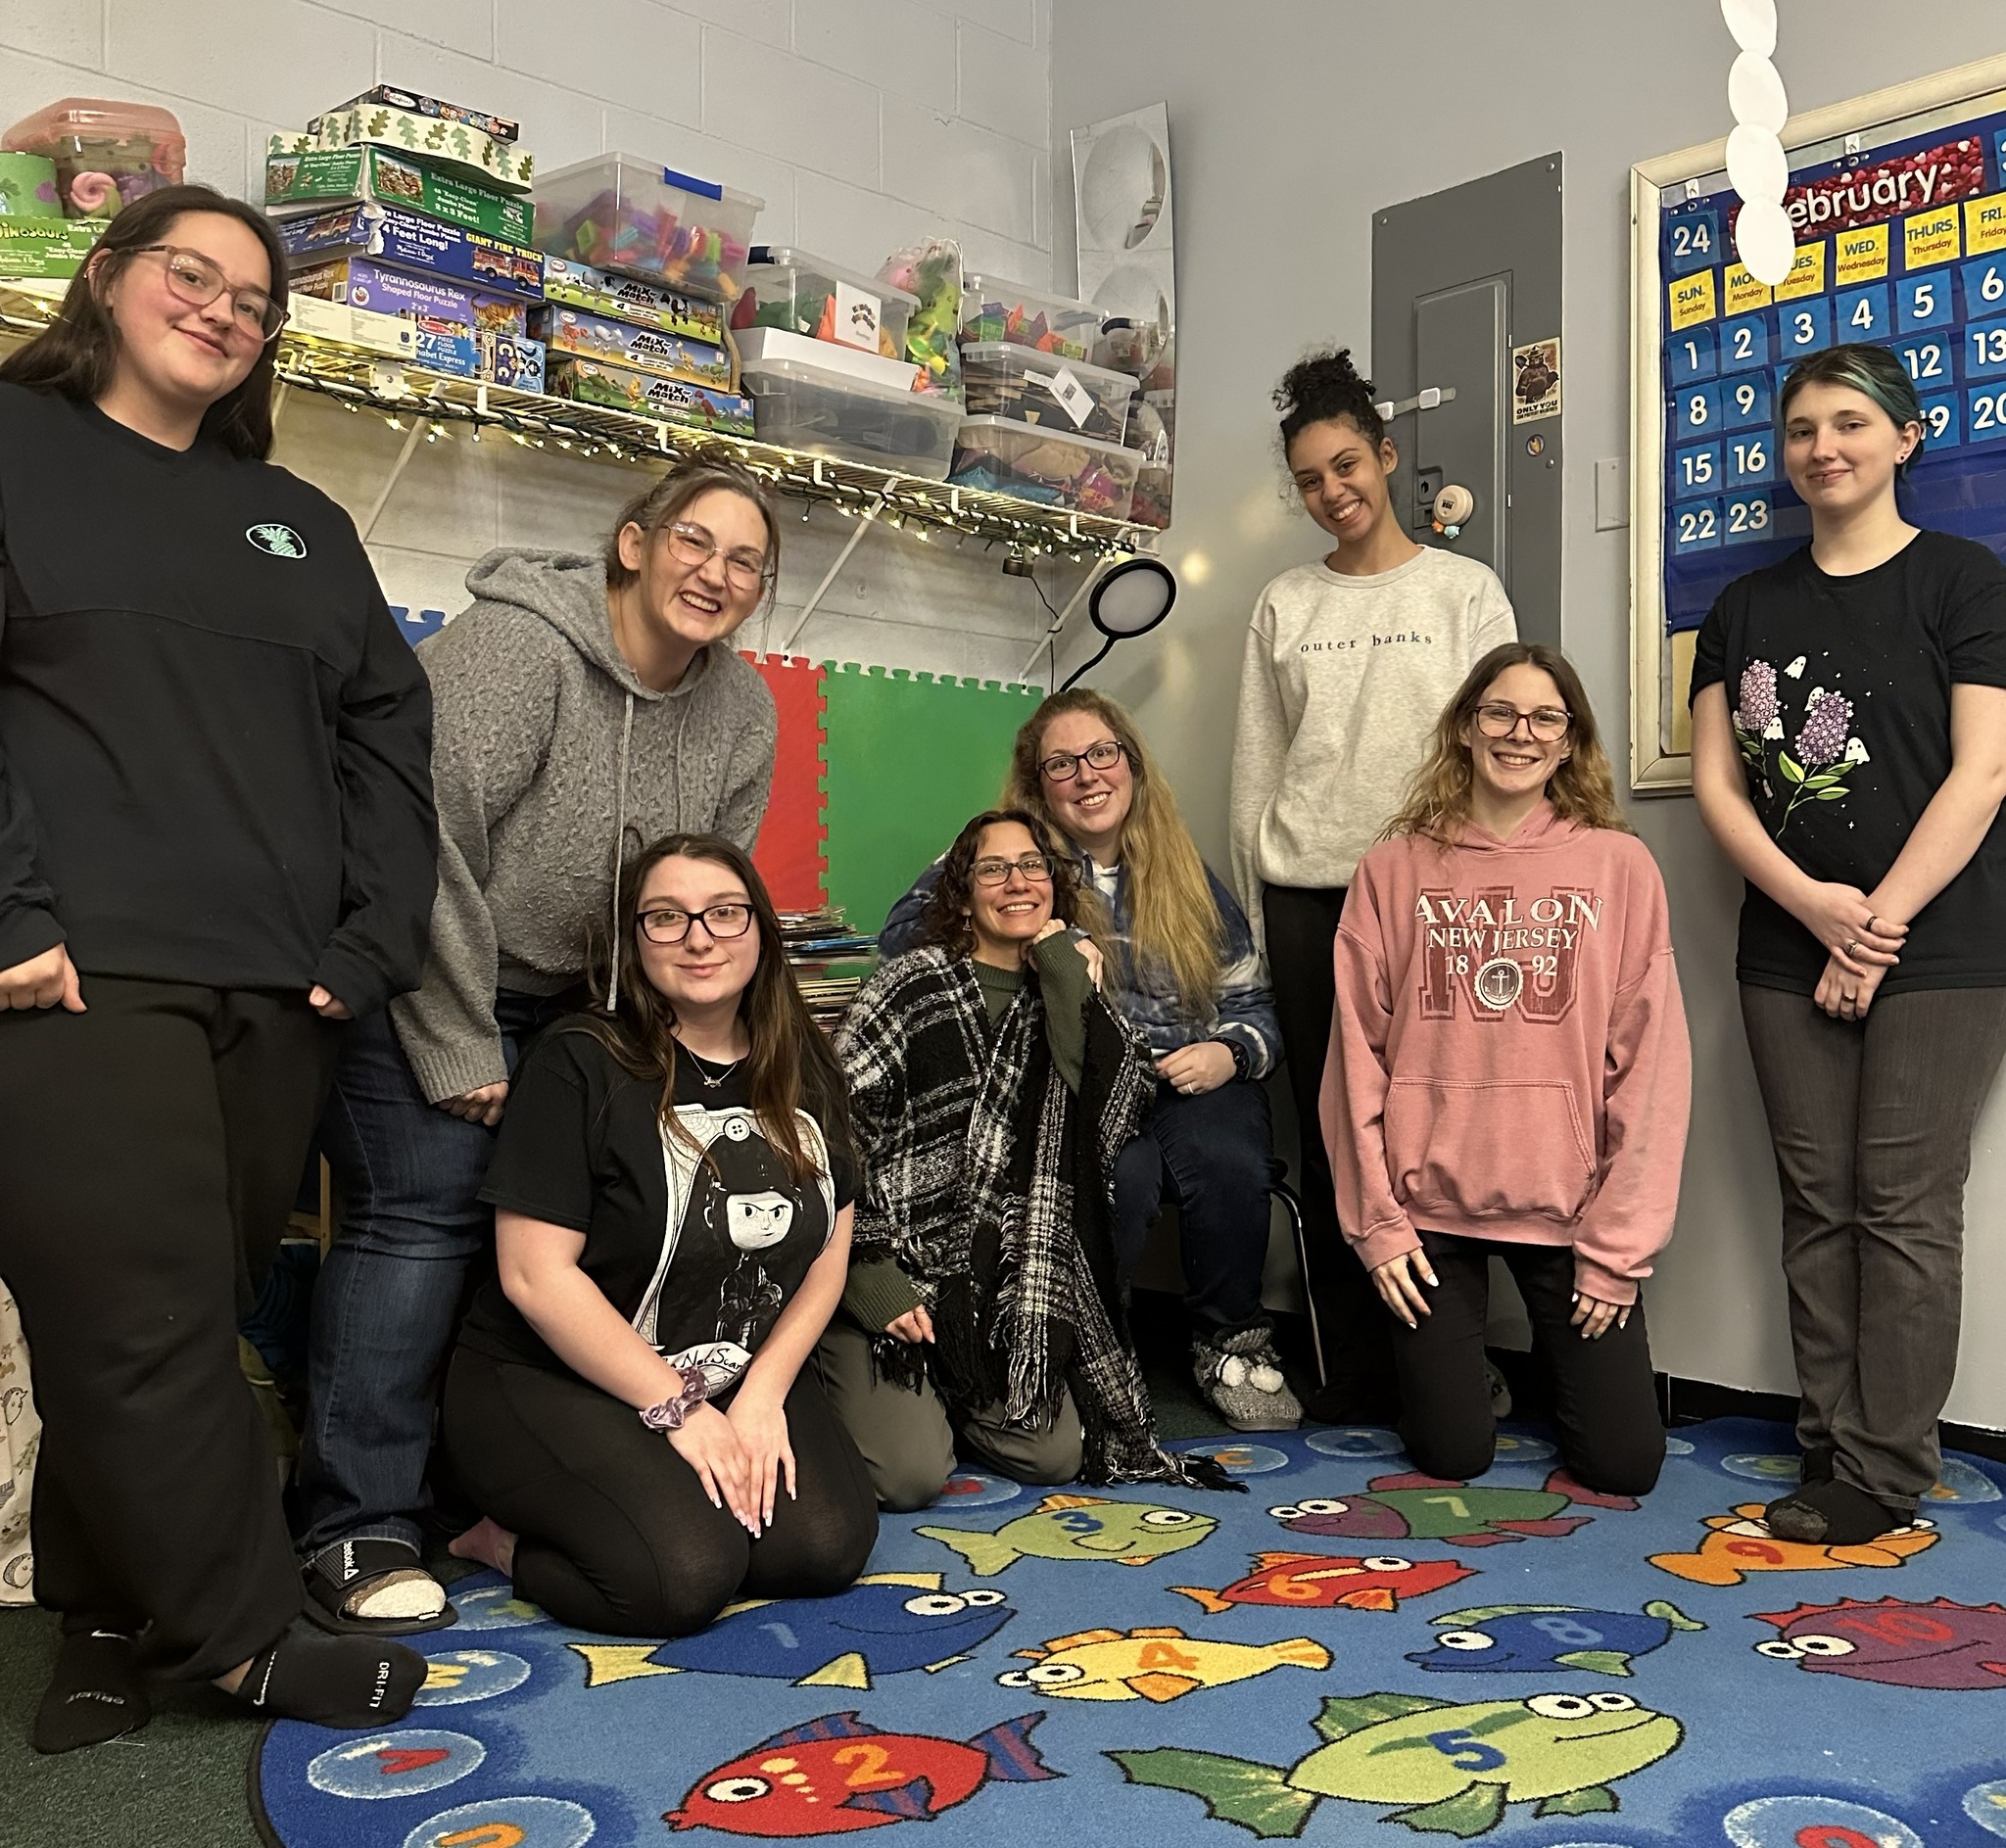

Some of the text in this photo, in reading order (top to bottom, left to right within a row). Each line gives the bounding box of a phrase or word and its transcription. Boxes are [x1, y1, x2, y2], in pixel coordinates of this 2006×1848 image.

[431, 171, 524, 212] Extra Large Floor Puzzle
[1788, 164, 1937, 228] ebruary
[393, 212, 415, 224] Large
[416, 217, 437, 229] Floor
[437, 224, 461, 237] Puzzle
[1981, 207, 2006, 223] FRI.
[382, 223, 391, 233] 4
[393, 226, 417, 241] Feet
[419, 233, 449, 252] Long!
[1674, 223, 1711, 257] 24
[1906, 218, 1957, 242] THURS.
[465, 232, 544, 262] GIANT FIRE TRUCK
[1844, 240, 1880, 257] WED.
[1912, 239, 1952, 256] Thursday
[1791, 256, 1817, 270] UES.
[1838, 256, 1887, 273] Wednesday
[373, 268, 466, 302] Tyrannosaurus Rex
[1730, 272, 1755, 288] MO
[1982, 266, 2005, 301] 6
[381, 283, 458, 308] Shaped Floor Puzzle
[617, 289, 655, 305] Match
[1677, 285, 1705, 304] SUN.
[1732, 287, 1763, 302] Monday
[1912, 284, 1934, 318] 5
[1679, 302, 1706, 316] Sunday
[1851, 298, 1874, 330] 4
[416, 331, 437, 350] 27
[437, 335, 454, 344] PIECE
[1793, 312, 1814, 345] 3
[630, 340, 668, 355] Match
[1685, 341, 1697, 370] 1
[1734, 328, 1753, 360] 2
[1973, 328, 2006, 364] 13
[439, 353, 466, 365] Express
[1903, 344, 1943, 380] 12
[647, 389, 689, 403] Match
[1516, 403, 1539, 414] ONLY
[1540, 400, 1558, 408] YOU
[1690, 395, 1707, 425] 8
[1735, 384, 1755, 415] 9
[1682, 452, 1713, 486] 15
[1734, 442, 1766, 475] 16
[1679, 508, 1716, 543] 22
[1729, 499, 1768, 533] 23
[1301, 630, 1433, 653] outer banks
[1415, 892, 1604, 932] AVALON
[1428, 926, 1578, 955] NEW JERSEY
[1445, 955, 1558, 977] 18 92
[1422, 1495, 1469, 1518] 7
[1050, 1511, 1104, 1535] 3
[1726, 1540, 1784, 1565] 9
[1269, 1574, 1322, 1600] 6
[759, 1624, 798, 1649] 1
[1532, 1616, 1604, 1646] 8
[1833, 1609, 1956, 1647] 10
[1137, 1642, 1200, 1671] 4
[377, 1748, 452, 1775] V
[832, 1743, 905, 1787] 2
[1426, 1730, 1506, 1773] 5
